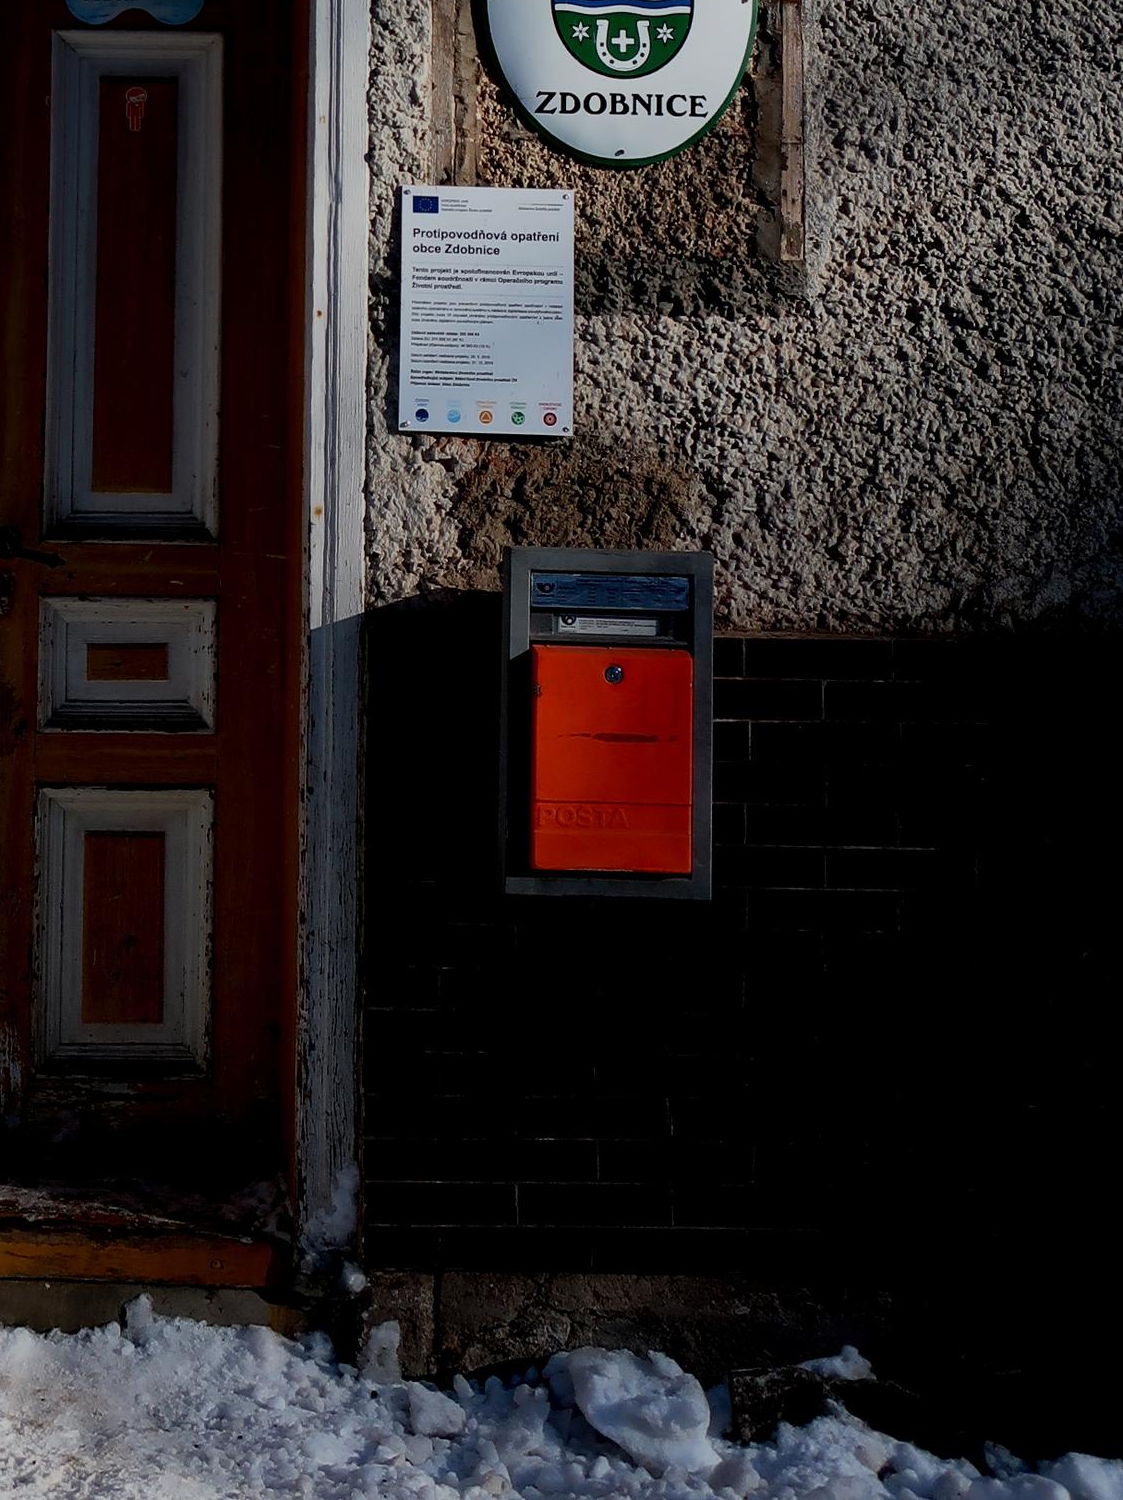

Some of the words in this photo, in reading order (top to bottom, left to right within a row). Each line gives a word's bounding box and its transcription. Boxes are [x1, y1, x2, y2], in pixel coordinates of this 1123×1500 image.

[534, 91, 709, 118] ZDOBNICE
[412, 228, 507, 241] Protipovodňová
[510, 231, 559, 244] opatření
[412, 244, 441, 254] obce
[444, 244, 500, 255] Zdobnice
